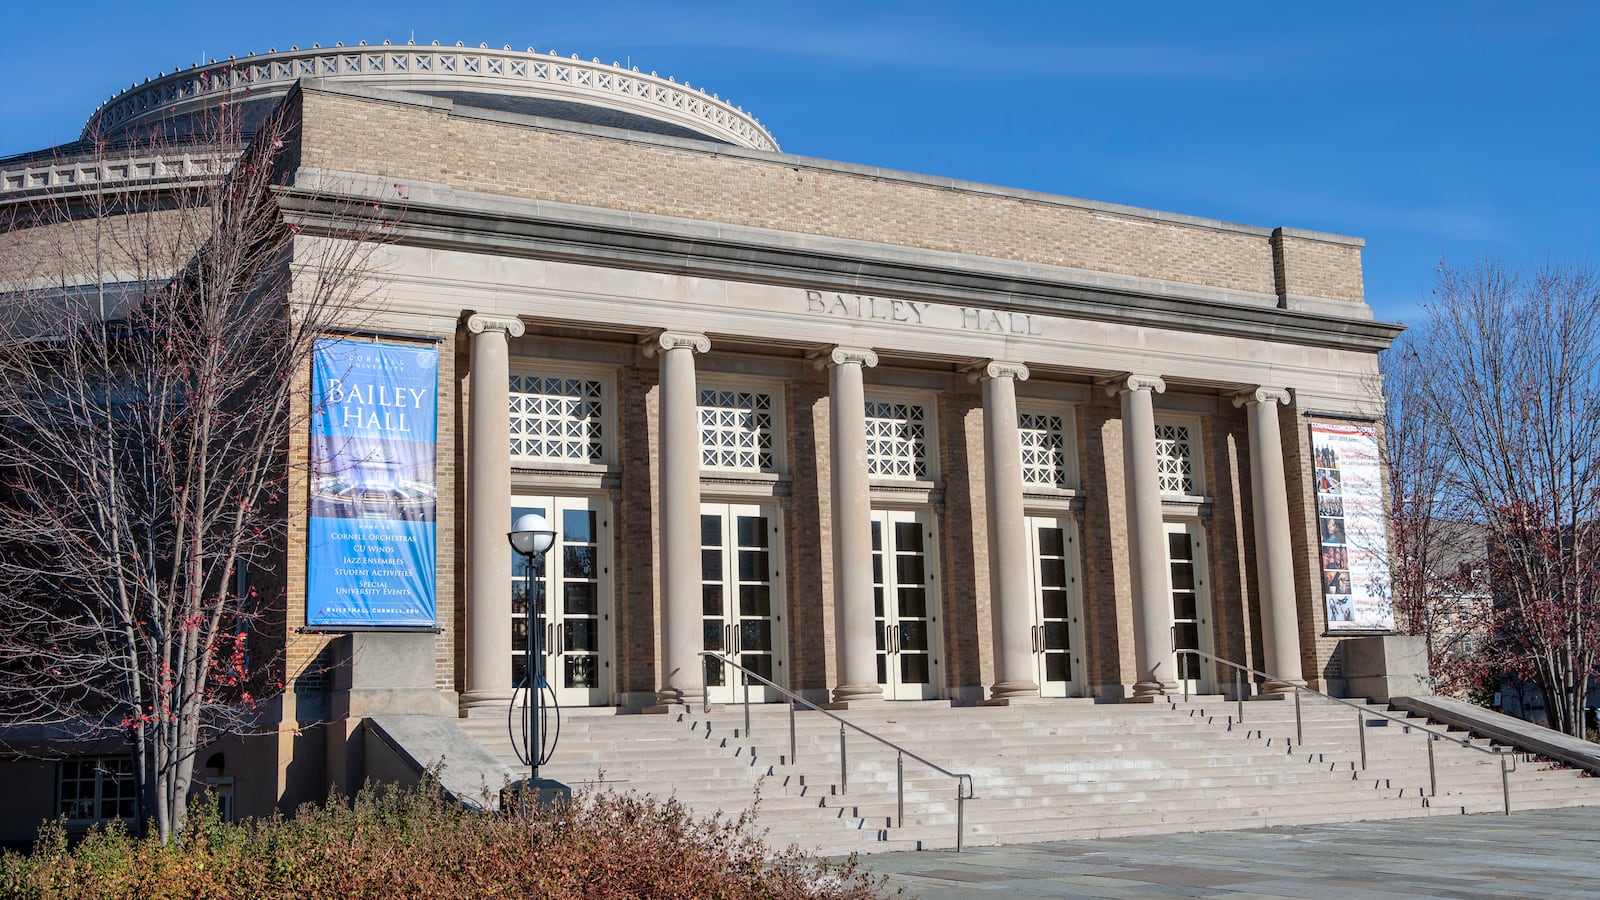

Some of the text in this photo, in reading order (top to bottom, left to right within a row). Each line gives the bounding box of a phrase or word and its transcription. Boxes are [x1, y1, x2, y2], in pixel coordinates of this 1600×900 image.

[805, 289, 1042, 336] BAILEY HALL
[328, 378, 427, 409] BAILEY
[343, 406, 410, 432] HALL
[331, 532, 417, 542] CORNELL ORCHESTRAS
[353, 544, 395, 553] CU WINDS
[343, 556, 404, 565] JAZZ ENSEMBLES
[334, 568, 413, 577] STUDENT ACTIVITIES
[383, 588, 411, 596] EVENTS
